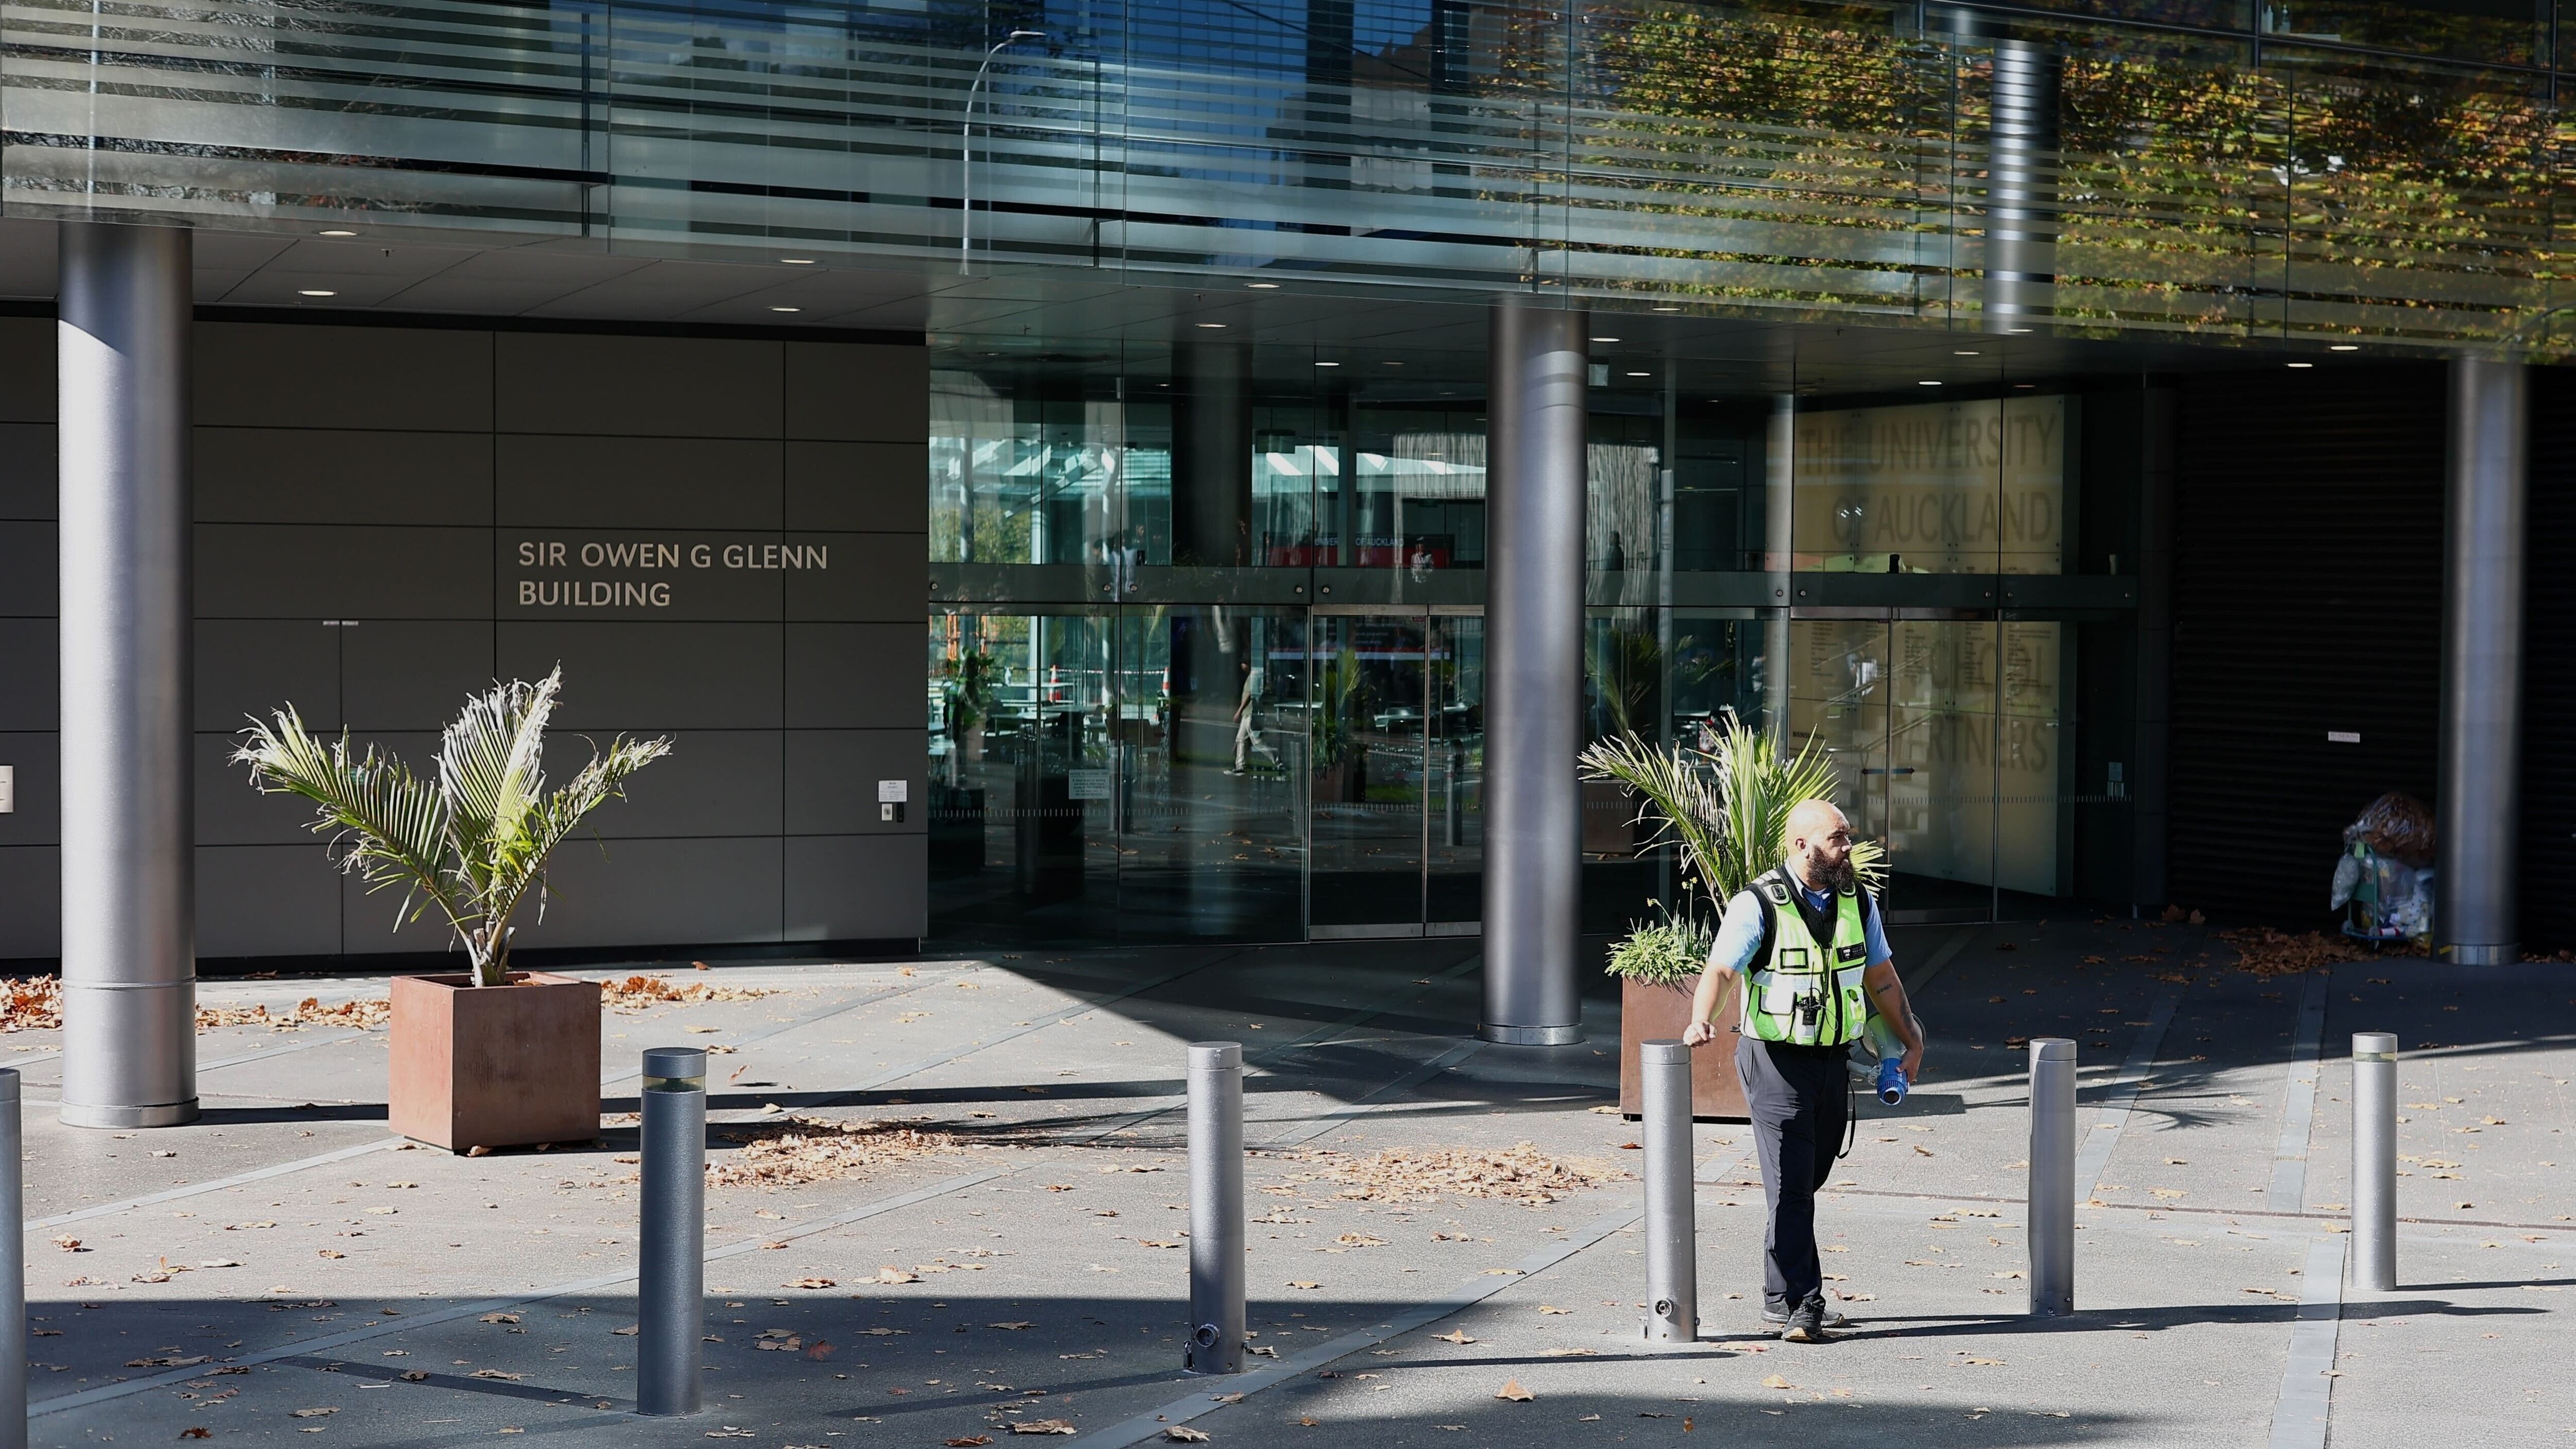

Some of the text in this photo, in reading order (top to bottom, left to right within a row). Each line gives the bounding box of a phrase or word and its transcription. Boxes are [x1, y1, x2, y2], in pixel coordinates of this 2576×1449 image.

[1868, 413, 2057, 471] UNIVERSITY
[1875, 491, 2053, 544] AUCKLAND
[519, 542, 827, 569] SIR OWEN G GLENN
[519, 581, 670, 606] BUILDING
